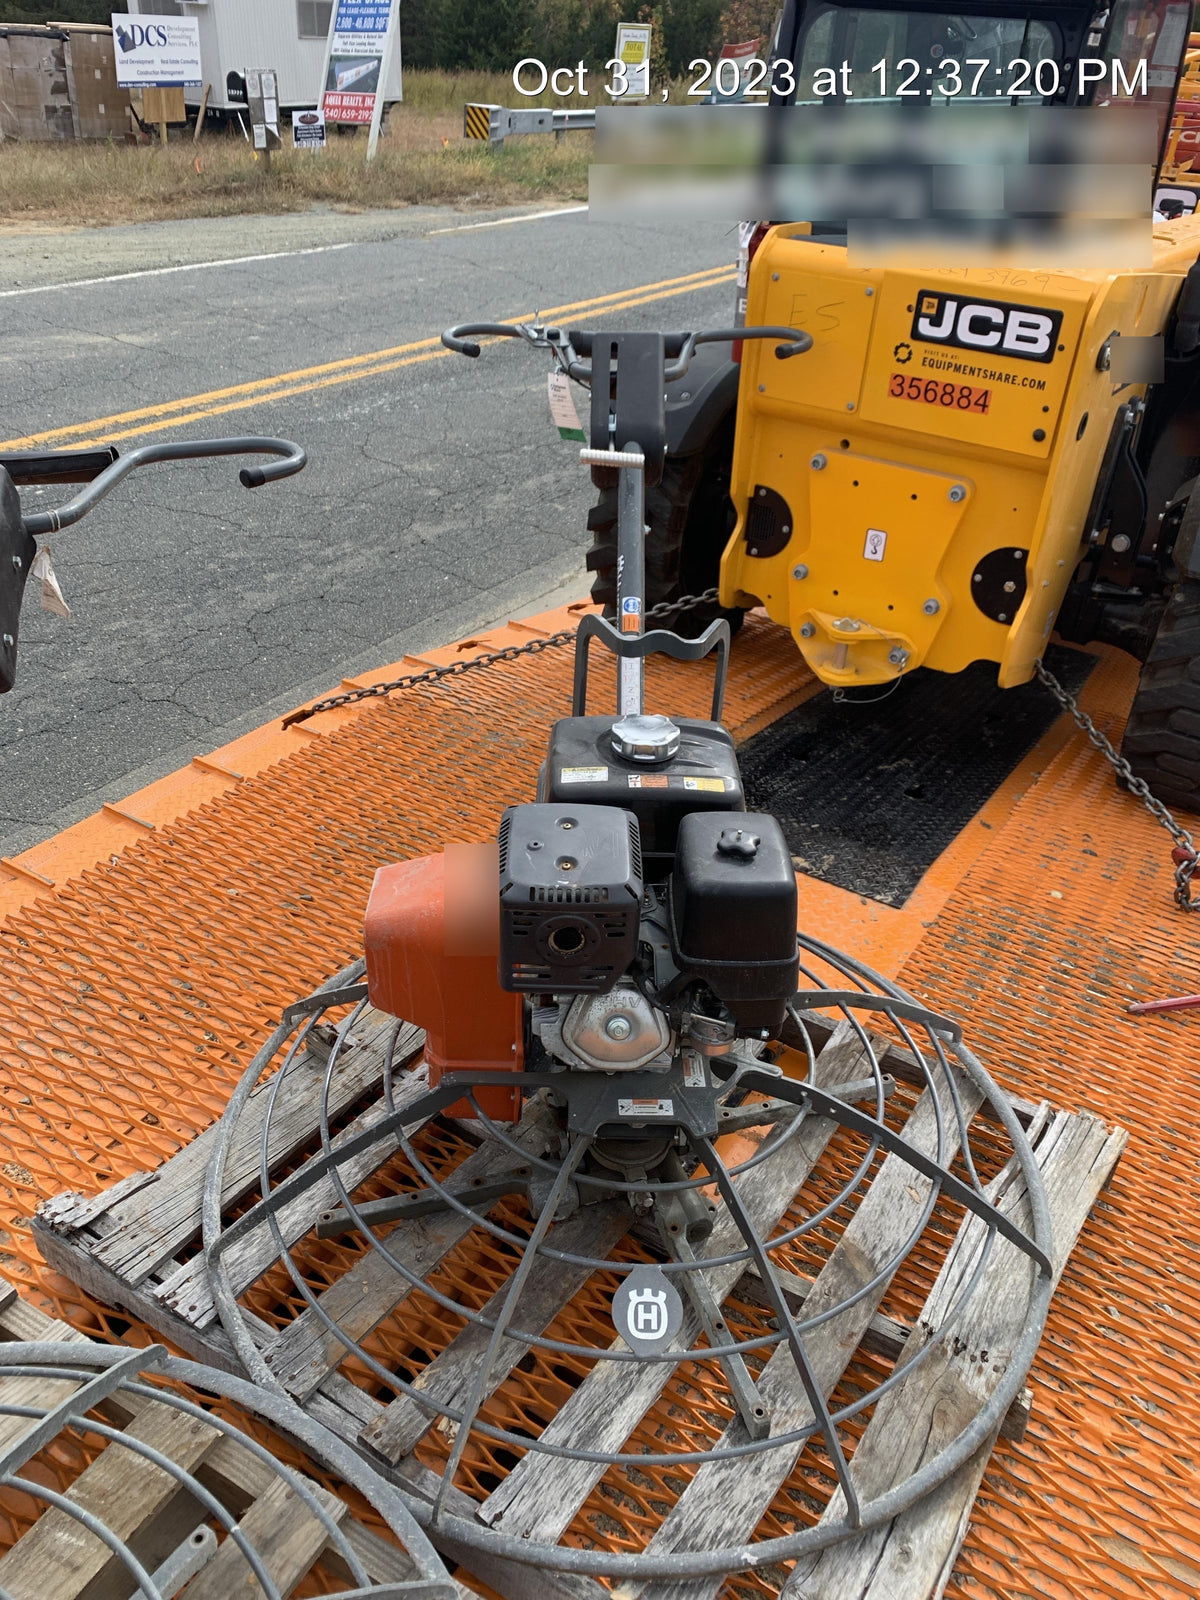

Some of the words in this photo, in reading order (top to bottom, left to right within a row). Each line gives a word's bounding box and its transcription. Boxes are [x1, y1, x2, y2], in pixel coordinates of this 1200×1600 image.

[130, 24, 167, 47] DCS
[323, 106, 342, 119] (540)
[342, 109, 373, 120] 659-2192
[325, 95, 341, 106] AQUIA
[917, 300, 1054, 354] JCB
[921, 356, 1047, 391] EQUIPMENTSHARE.COM
[890, 374, 990, 413] 356884
